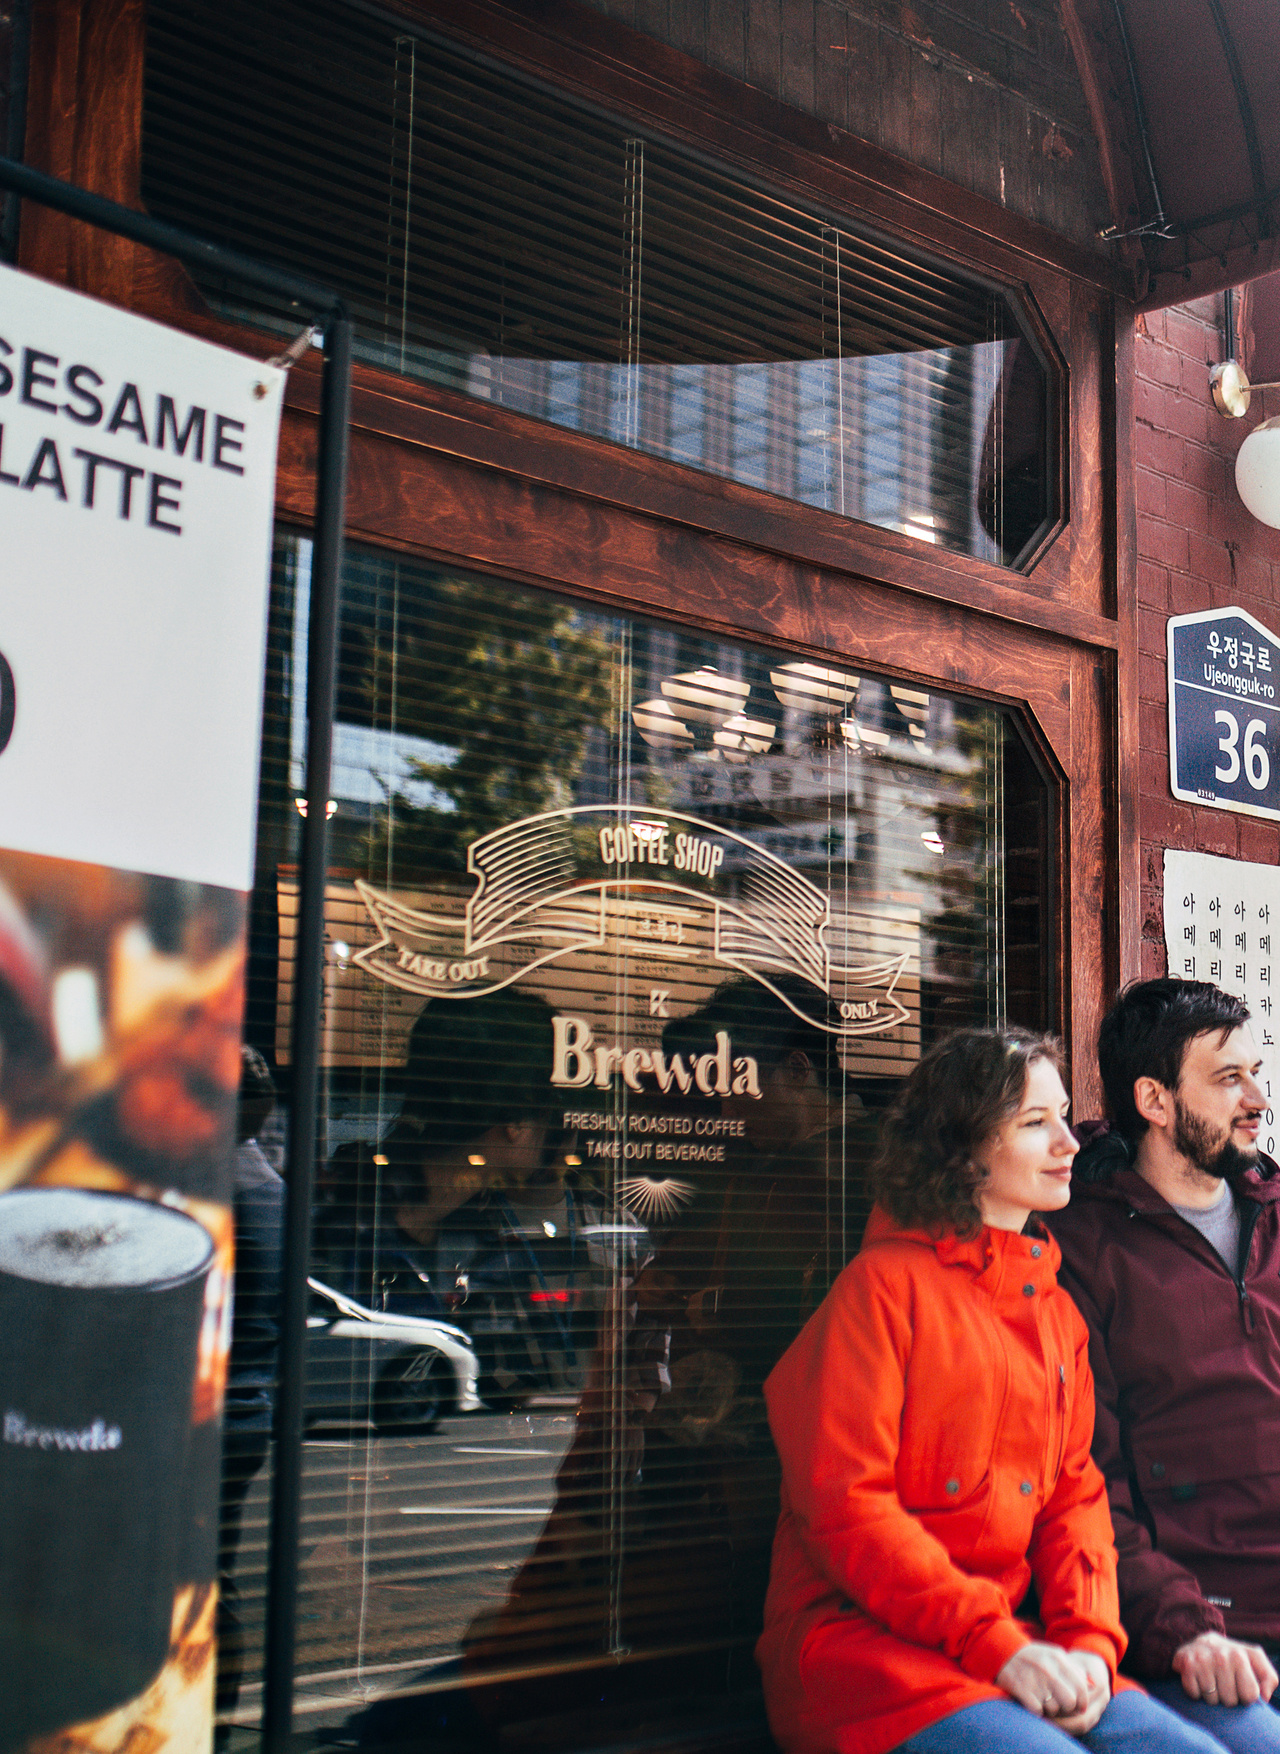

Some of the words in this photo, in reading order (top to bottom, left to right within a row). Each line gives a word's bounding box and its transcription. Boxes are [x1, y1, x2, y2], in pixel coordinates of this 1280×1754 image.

[1206, 631, 1273, 674] 우정국로
[1203, 662, 1275, 699] Ujeongguk-ro
[1214, 709, 1271, 791] 36
[599, 826, 670, 866] COFFEE
[673, 832, 725, 879] SHOP
[1182, 892, 1196, 979] 아메리
[1208, 896, 1222, 981] 아메리
[396, 945, 448, 982] TAKE
[449, 955, 492, 983] OUT
[839, 998, 879, 1020] ONLY
[550, 1015, 764, 1100] Brewda
[562, 1111, 626, 1132] FRESHLY
[628, 1114, 693, 1135] ROASTED
[695, 1118, 746, 1138] COFFEE
[585, 1140, 621, 1159] TAKE
[623, 1142, 654, 1161] OUT
[655, 1143, 727, 1163] BEVERAGE
[3, 1407, 123, 1452] Brewda
